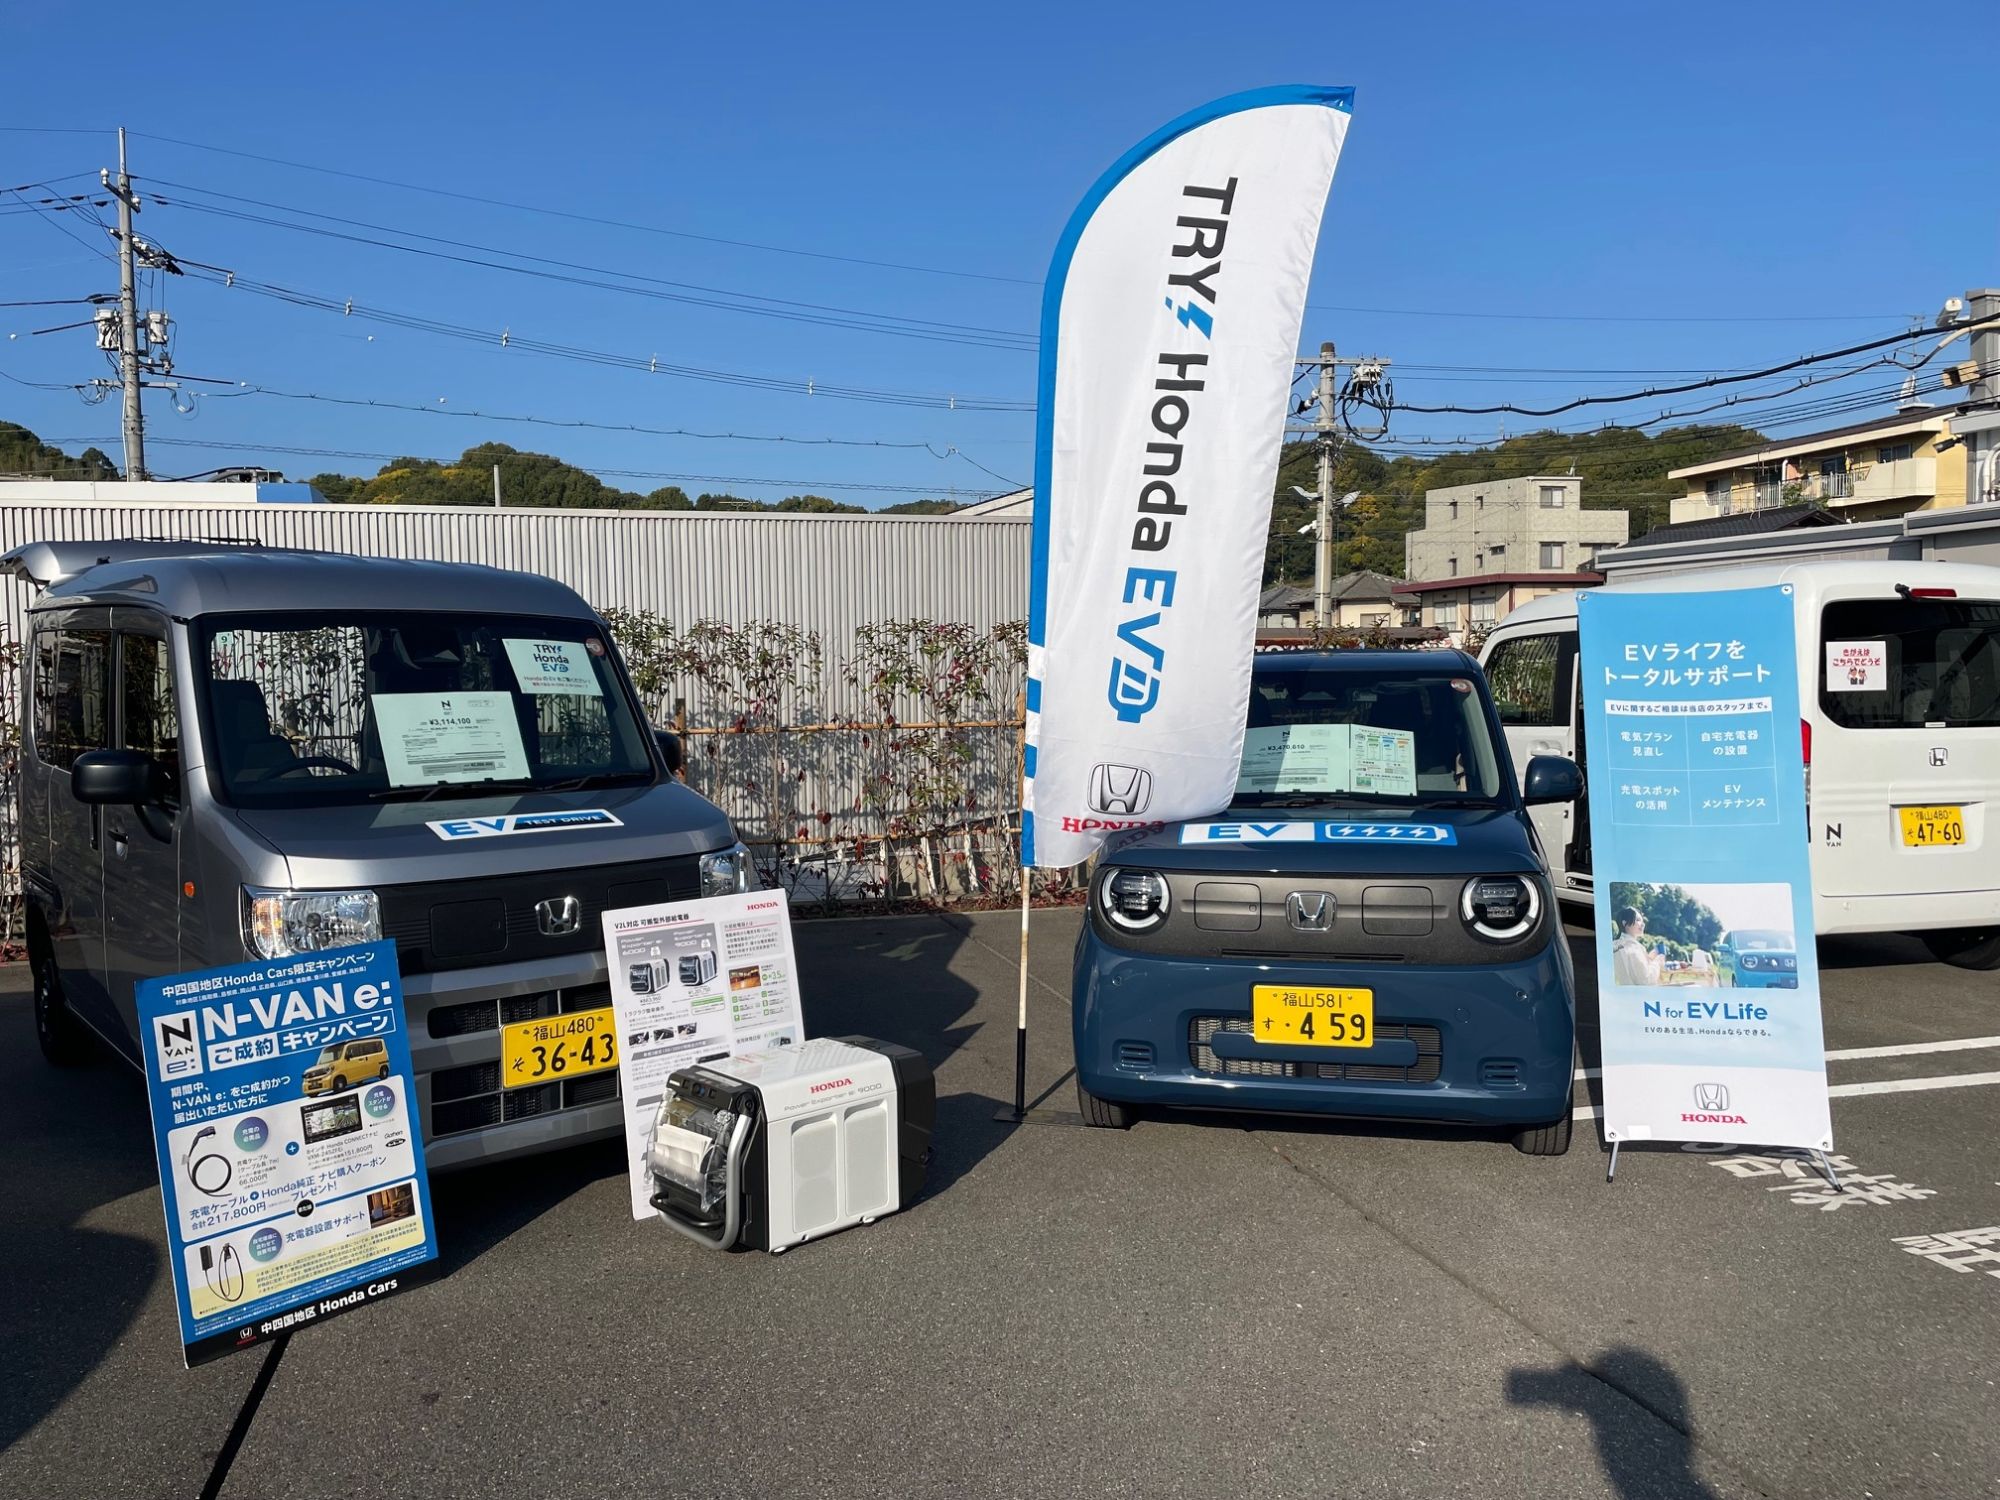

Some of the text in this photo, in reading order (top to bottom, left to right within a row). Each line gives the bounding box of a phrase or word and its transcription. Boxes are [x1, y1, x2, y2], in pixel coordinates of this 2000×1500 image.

[1131, 353, 1209, 552] Honda
[533, 653, 570, 664] Honda
[1625, 639, 1746, 662] EVライフを
[1604, 663, 1772, 687] トータルサポート
[1620, 731, 1673, 743] 電気プラン
[1701, 730, 1759, 742] 自宅充電器
[1632, 746, 1664, 757] 見直し
[1713, 745, 1748, 757] の設置
[1620, 784, 1681, 797] 充電スポット
[1724, 784, 1742, 794] EV
[1635, 799, 1668, 811] の活用
[1702, 797, 1767, 809] メンテナンス
[440, 814, 602, 836] EV TEST DRIVE
[1208, 824, 1289, 839] EV
[1826, 823, 1841, 840] N
[1918, 822, 1961, 842] 47-60
[747, 901, 779, 911] HONDA
[1283, 992, 1342, 1008] 福山581
[202, 981, 393, 1041] N-VAN e:
[1643, 1001, 1661, 1018] N
[1665, 1007, 1684, 1018] for
[533, 1017, 595, 1041] 福山480
[1262, 1017, 1274, 1031] す
[161, 1018, 191, 1048] N
[283, 1015, 388, 1050] キャンペーン
[164, 1045, 194, 1057] VAN
[532, 1034, 613, 1076] 36-43
[810, 1078, 852, 1094] HONDA
[858, 1083, 882, 1094] 9000
[1680, 1113, 1748, 1125] HONDA
[190, 1195, 249, 1220] 充電ケーブル
[286, 1211, 366, 1244] 充電器設置サポート
[261, 1308, 316, 1335] 中四国地区
[320, 1290, 366, 1314] Honda
[368, 1278, 398, 1298] Cars
